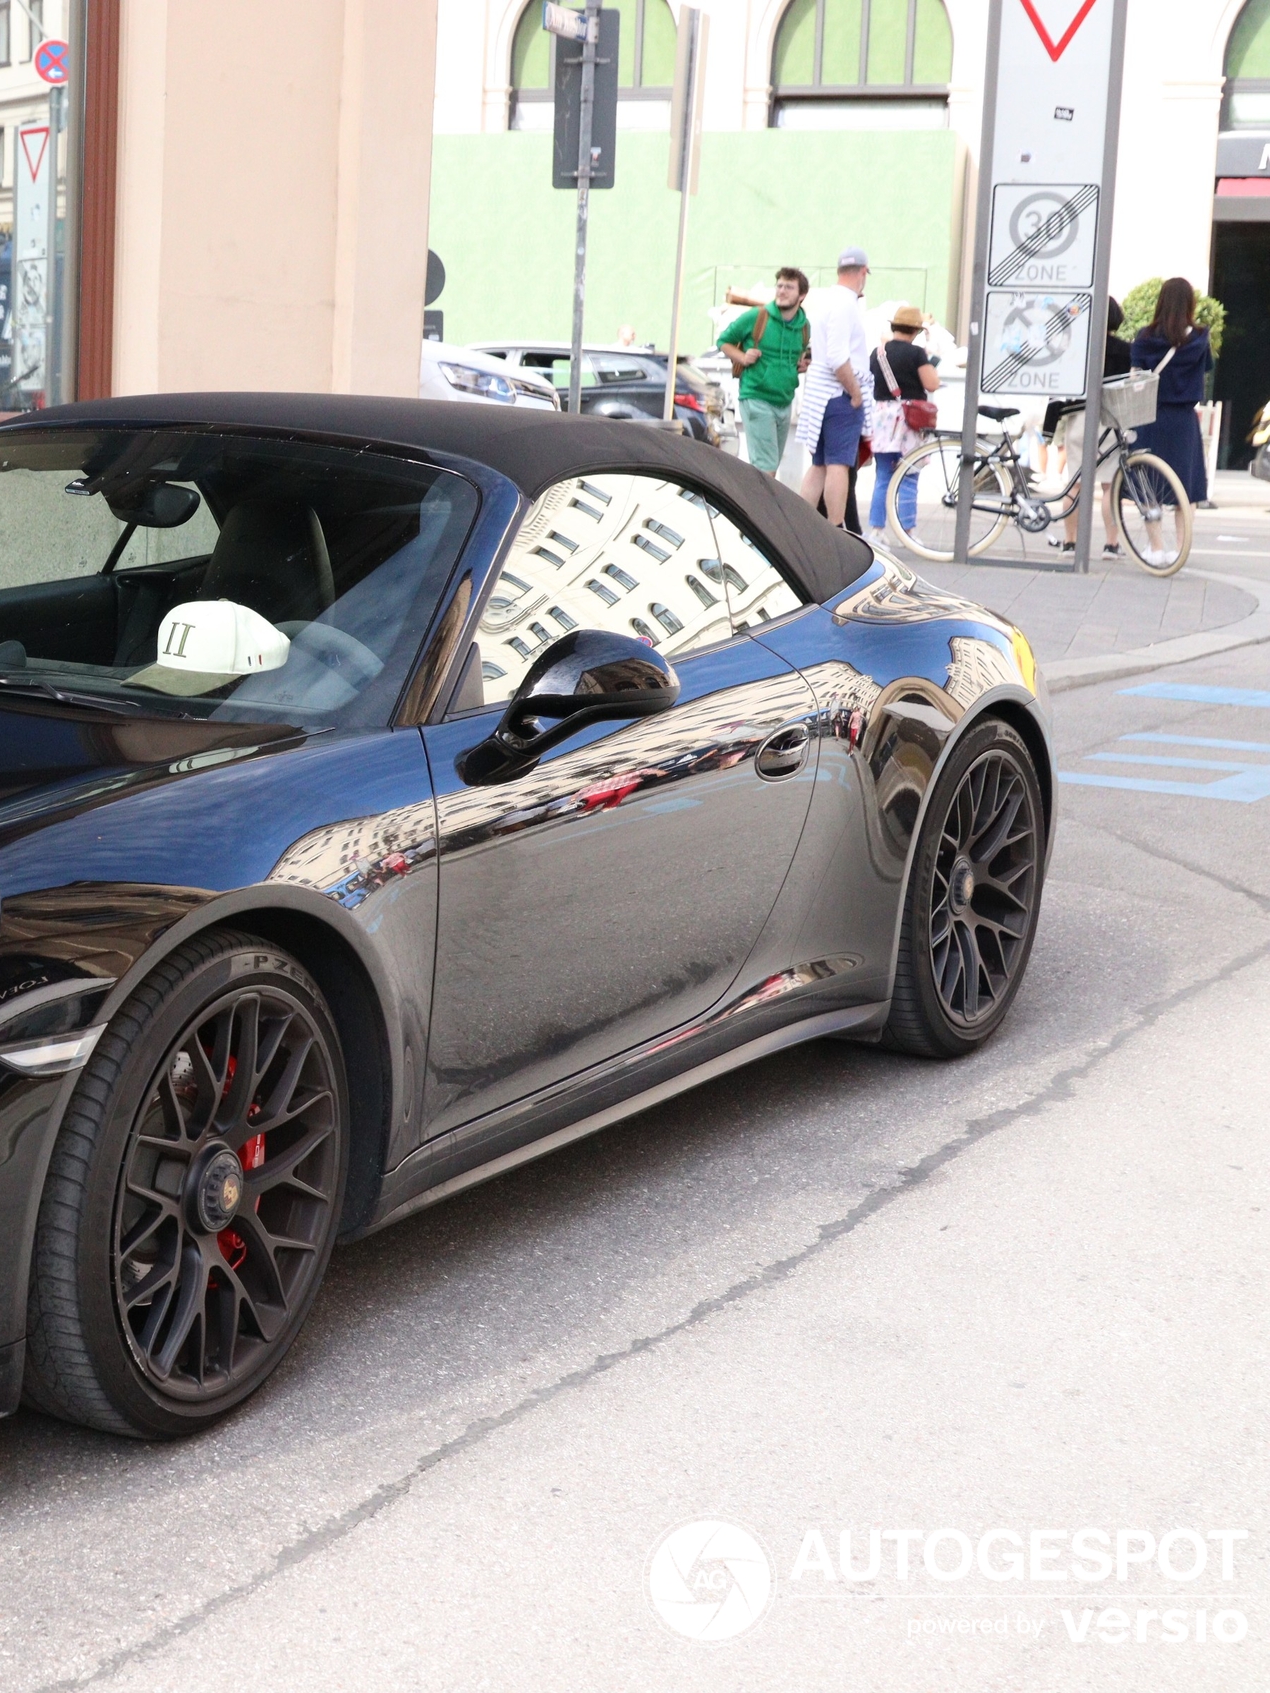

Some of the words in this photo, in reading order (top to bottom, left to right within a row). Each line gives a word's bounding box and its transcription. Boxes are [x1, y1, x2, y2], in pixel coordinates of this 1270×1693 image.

[1024, 211, 1064, 241] 30
[1014, 264, 1068, 282] ZONE
[1007, 371, 1060, 389] ZONE
